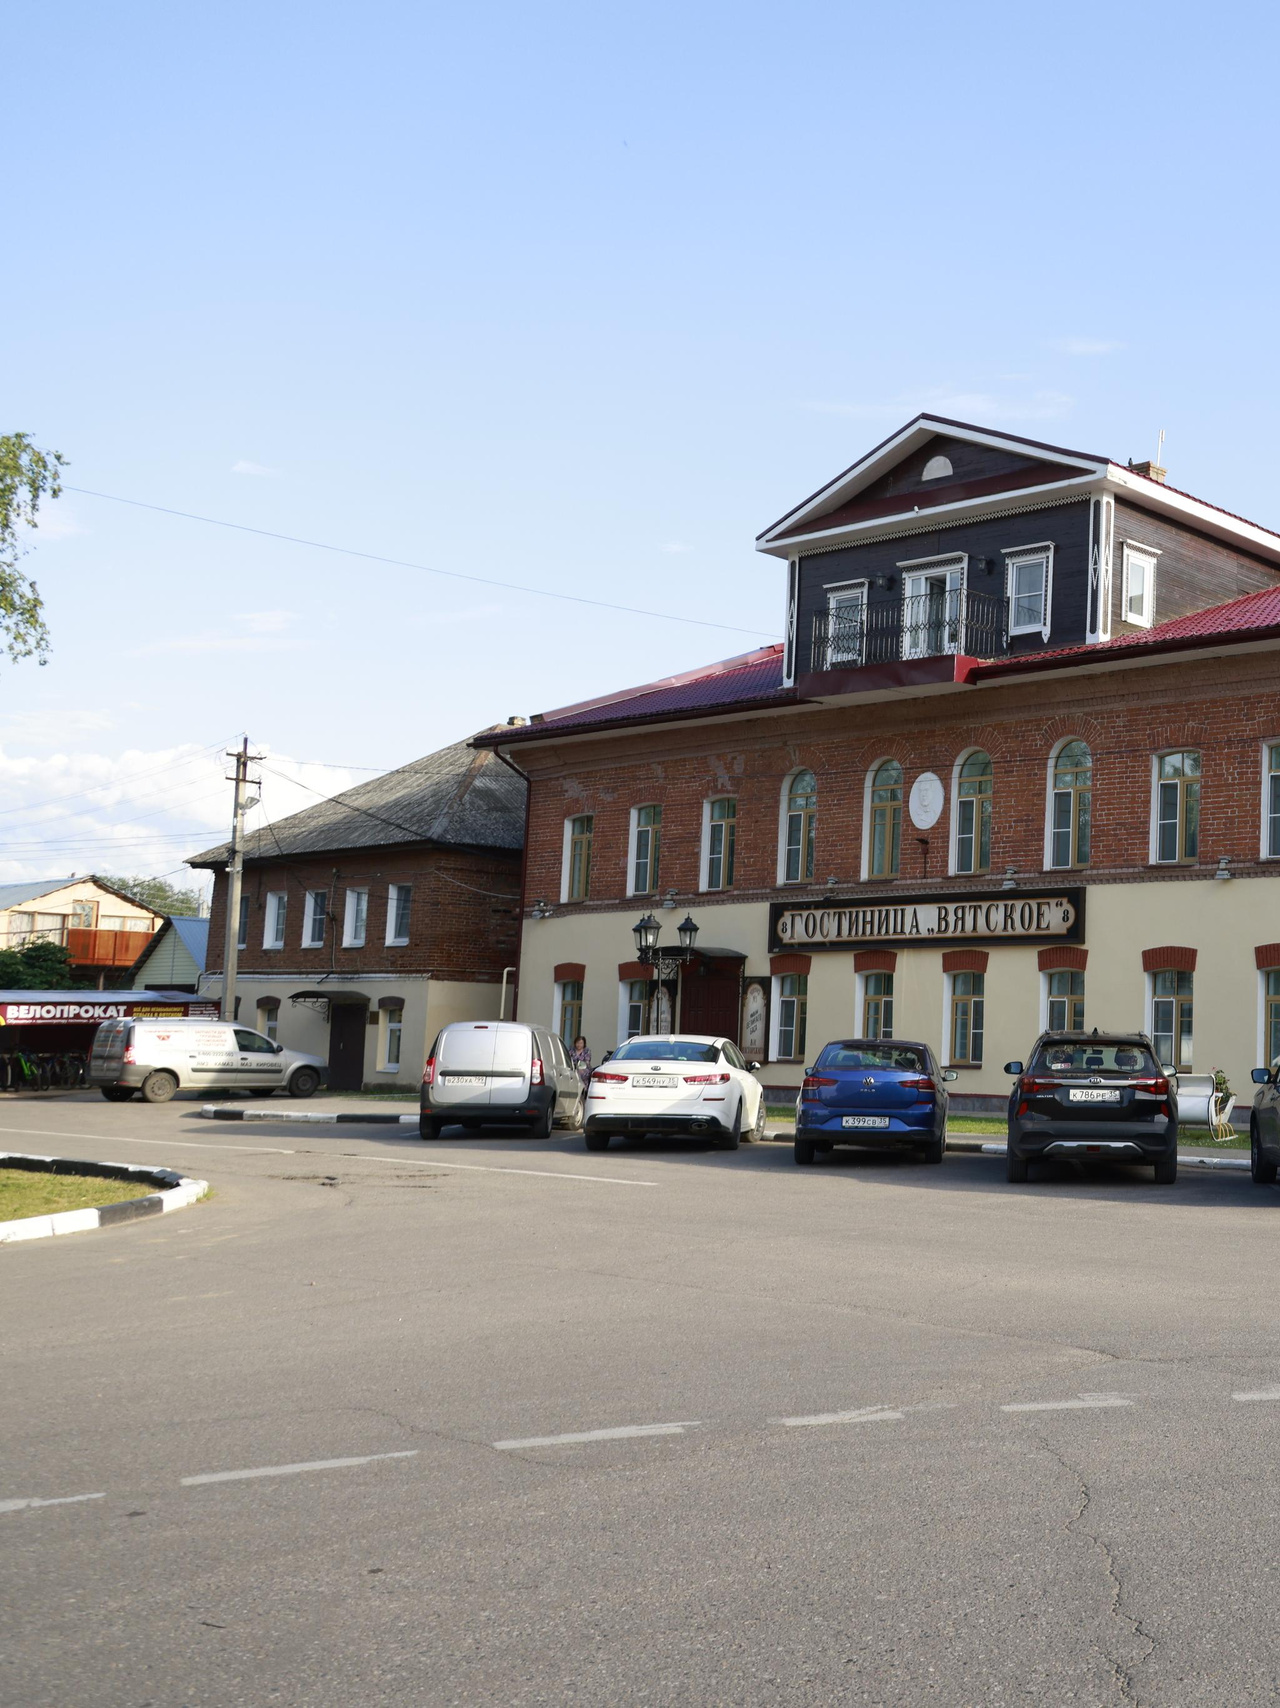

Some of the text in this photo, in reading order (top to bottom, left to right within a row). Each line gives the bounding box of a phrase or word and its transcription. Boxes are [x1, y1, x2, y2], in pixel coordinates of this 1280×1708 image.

[781, 921, 788, 934] 8
[788, 906, 922, 940] ГОСТИНИЦА
[1062, 908, 1070, 923] 8
[6, 1004, 127, 1019] ВЕЛОПРОКАТ
[636, 1076, 666, 1085] К549НУ
[1072, 1090, 1107, 1099] К786РЕ
[845, 1117, 877, 1126] К399СВ
